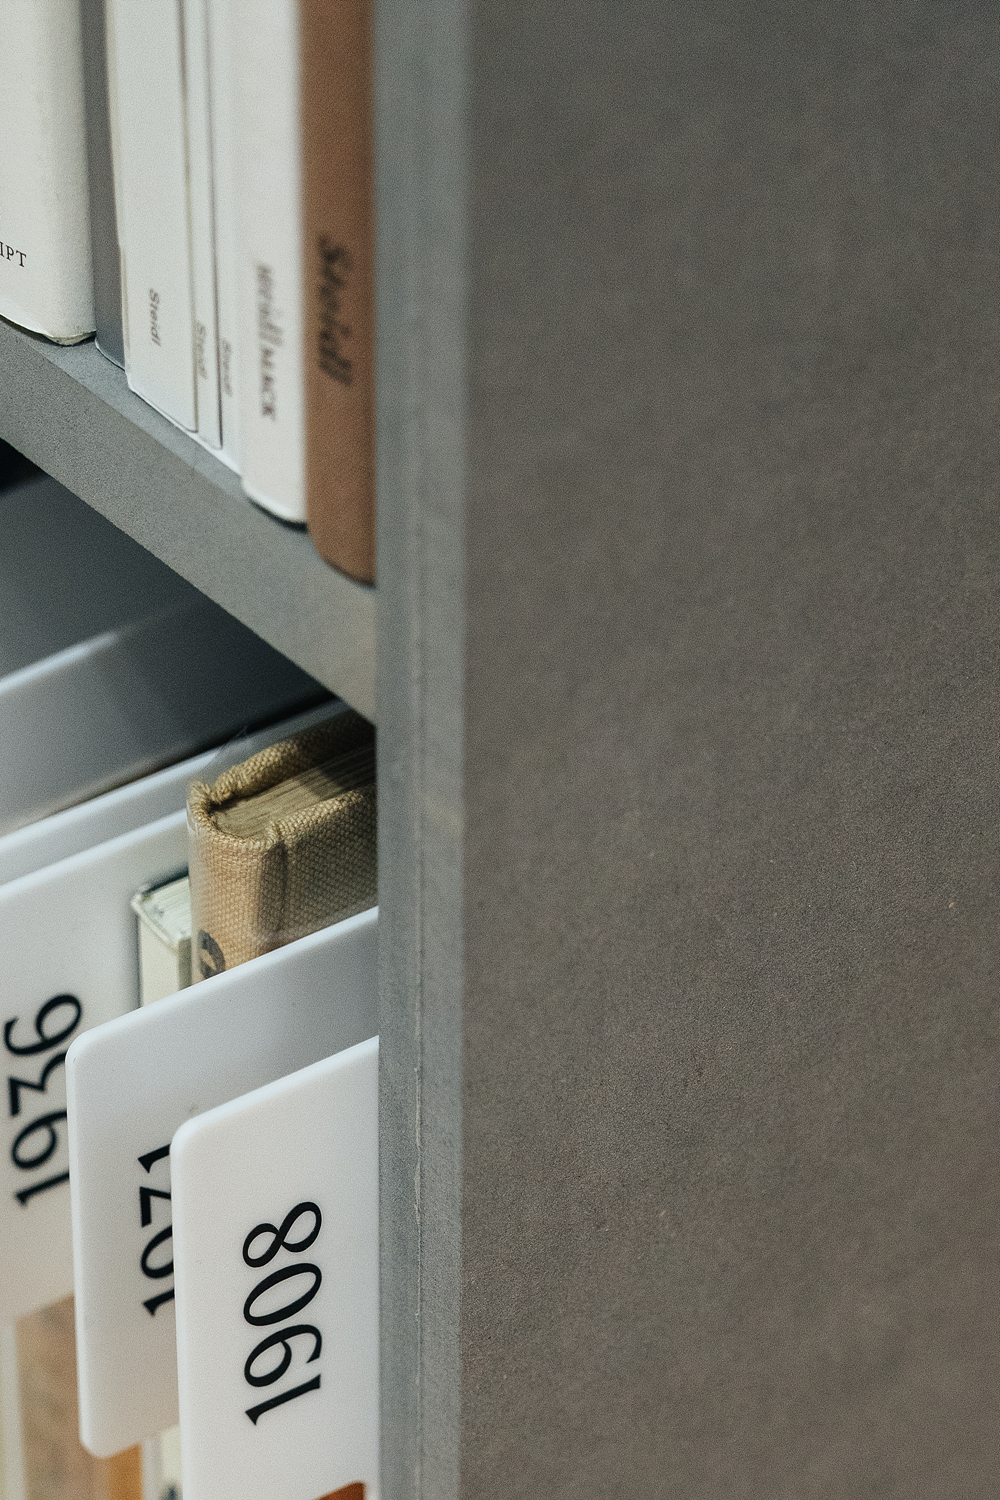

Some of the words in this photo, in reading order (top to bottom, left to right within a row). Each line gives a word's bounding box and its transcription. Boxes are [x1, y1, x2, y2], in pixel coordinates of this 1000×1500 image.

[149, 287, 162, 347] Steidl
[317, 233, 353, 388] Steidl
[3, 993, 83, 1208] 1936
[241, 1200, 323, 1426] 1908
